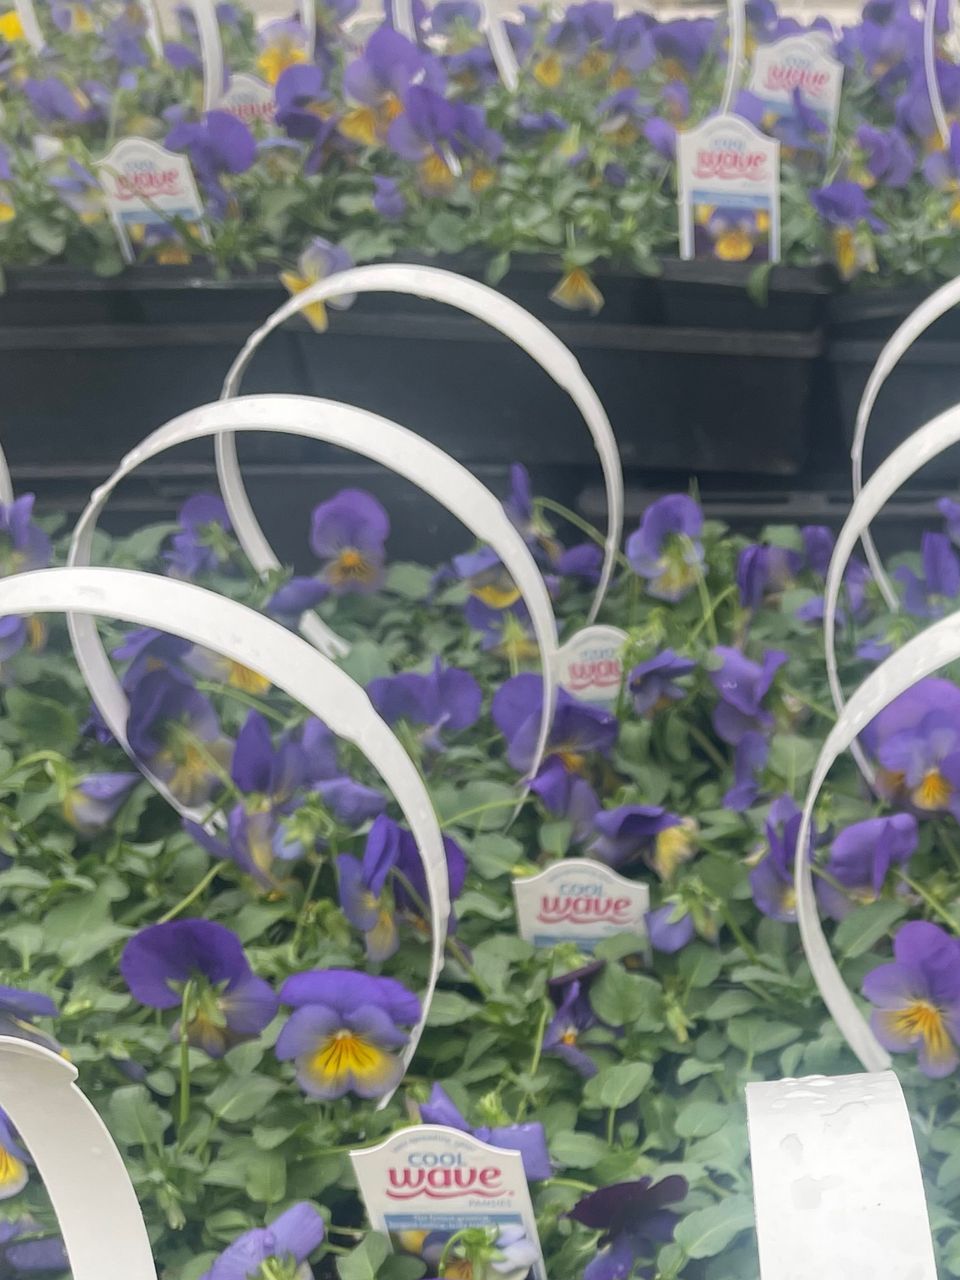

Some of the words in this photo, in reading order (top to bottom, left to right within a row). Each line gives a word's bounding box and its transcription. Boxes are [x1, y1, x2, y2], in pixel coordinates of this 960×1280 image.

[541, 895, 632, 915] wave
[408, 1152, 467, 1167] COOL
[388, 1166, 503, 1189] wave
